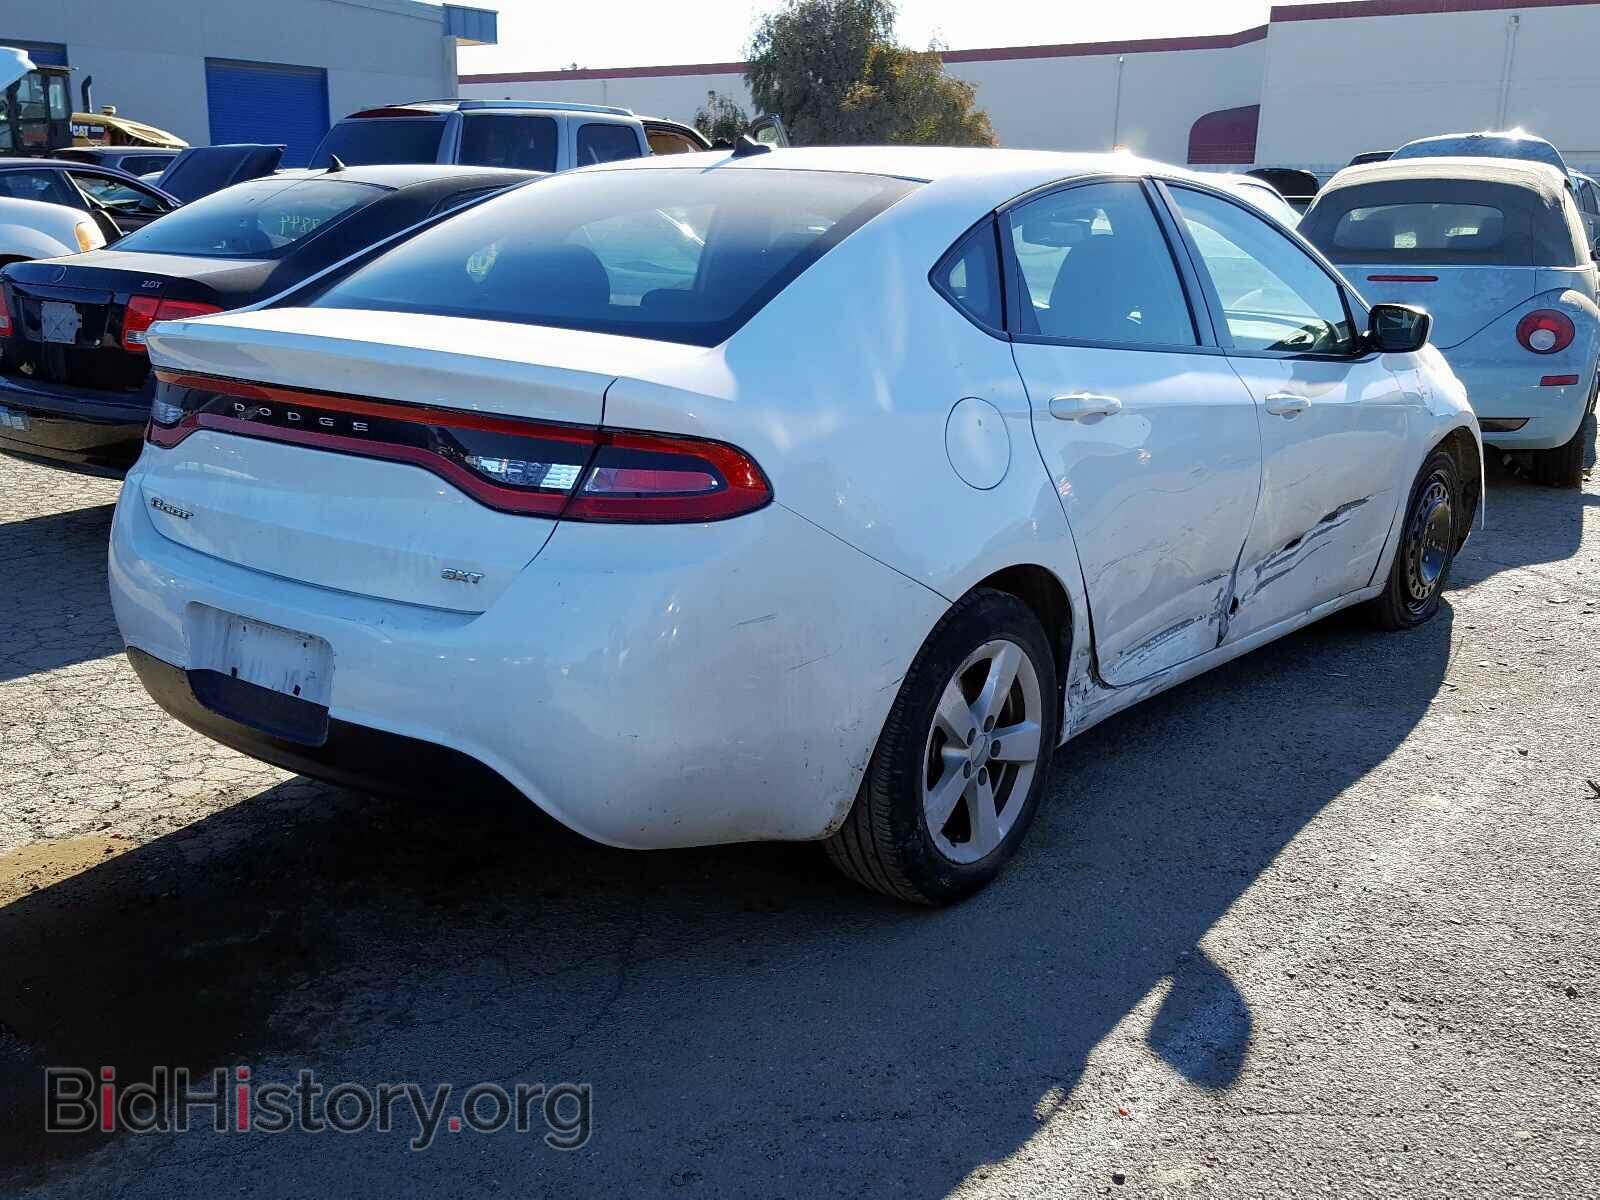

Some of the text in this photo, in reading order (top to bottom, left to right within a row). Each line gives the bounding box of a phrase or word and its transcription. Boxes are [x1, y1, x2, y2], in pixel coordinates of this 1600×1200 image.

[72, 125, 89, 137] CAT
[234, 402, 369, 432] DODGE
[441, 568, 485, 585] SXT
